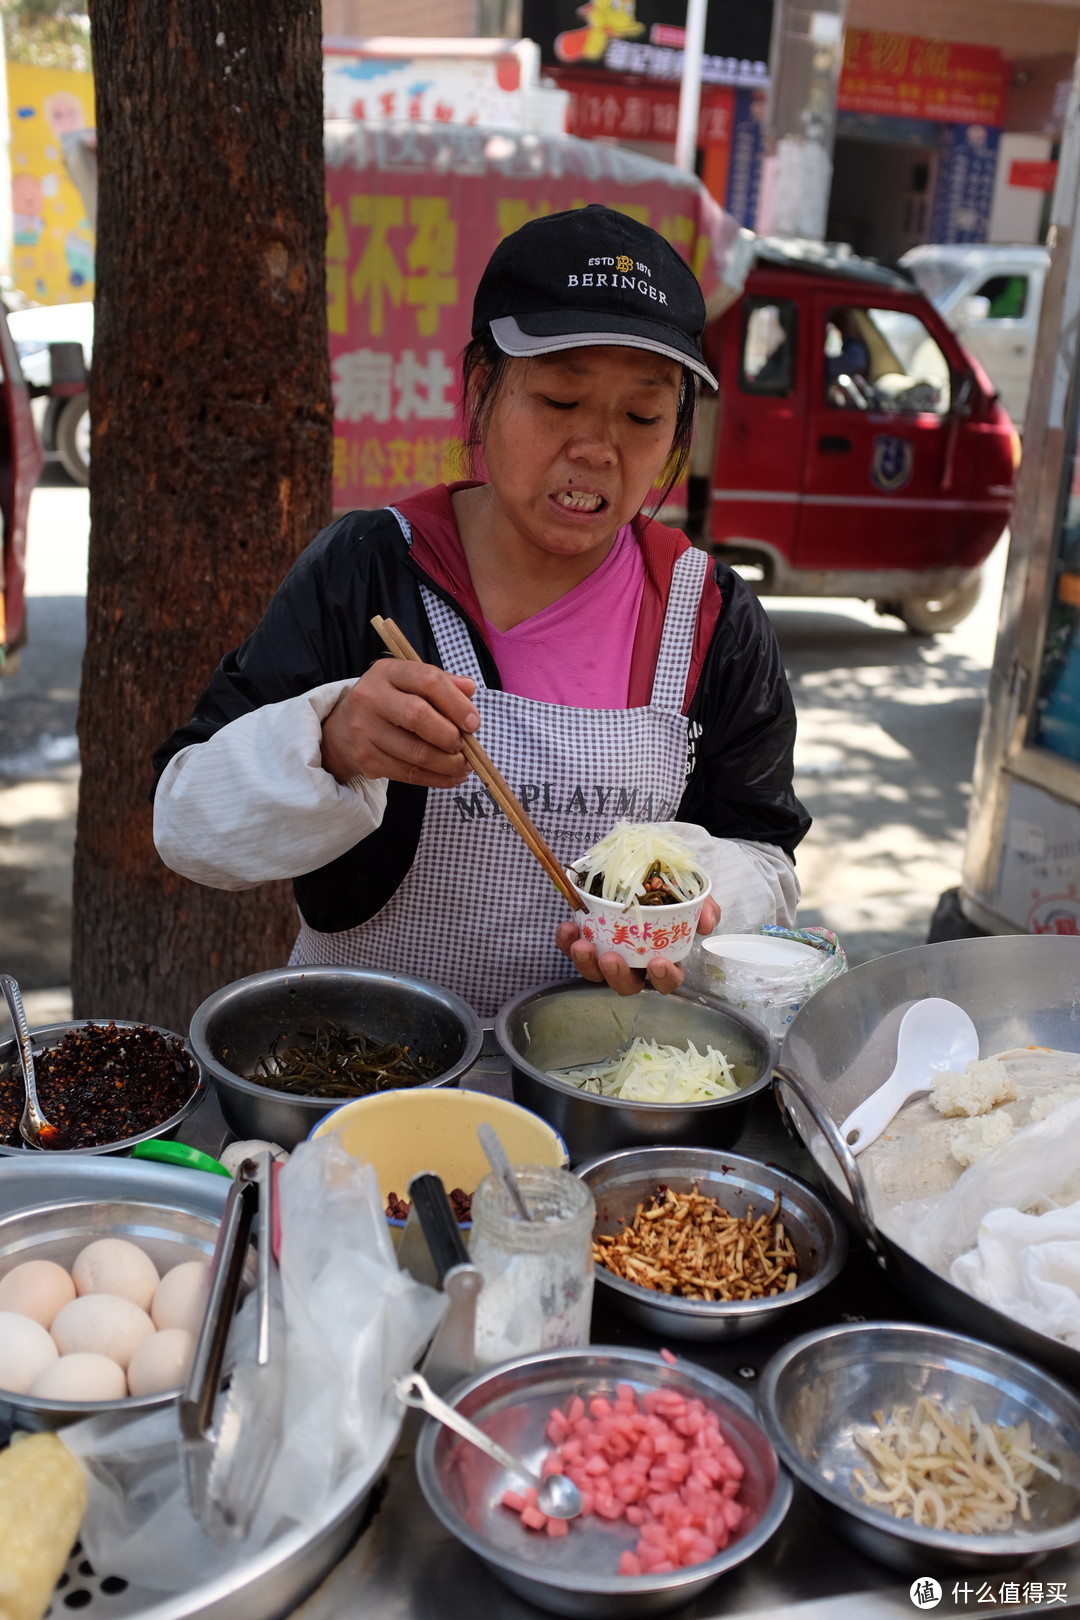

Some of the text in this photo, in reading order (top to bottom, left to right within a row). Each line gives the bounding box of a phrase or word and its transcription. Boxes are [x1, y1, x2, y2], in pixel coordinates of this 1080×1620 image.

[588, 257, 615, 266] ESTD
[567, 273, 668, 306] BERINGER
[332, 348, 455, 424] 病灶
